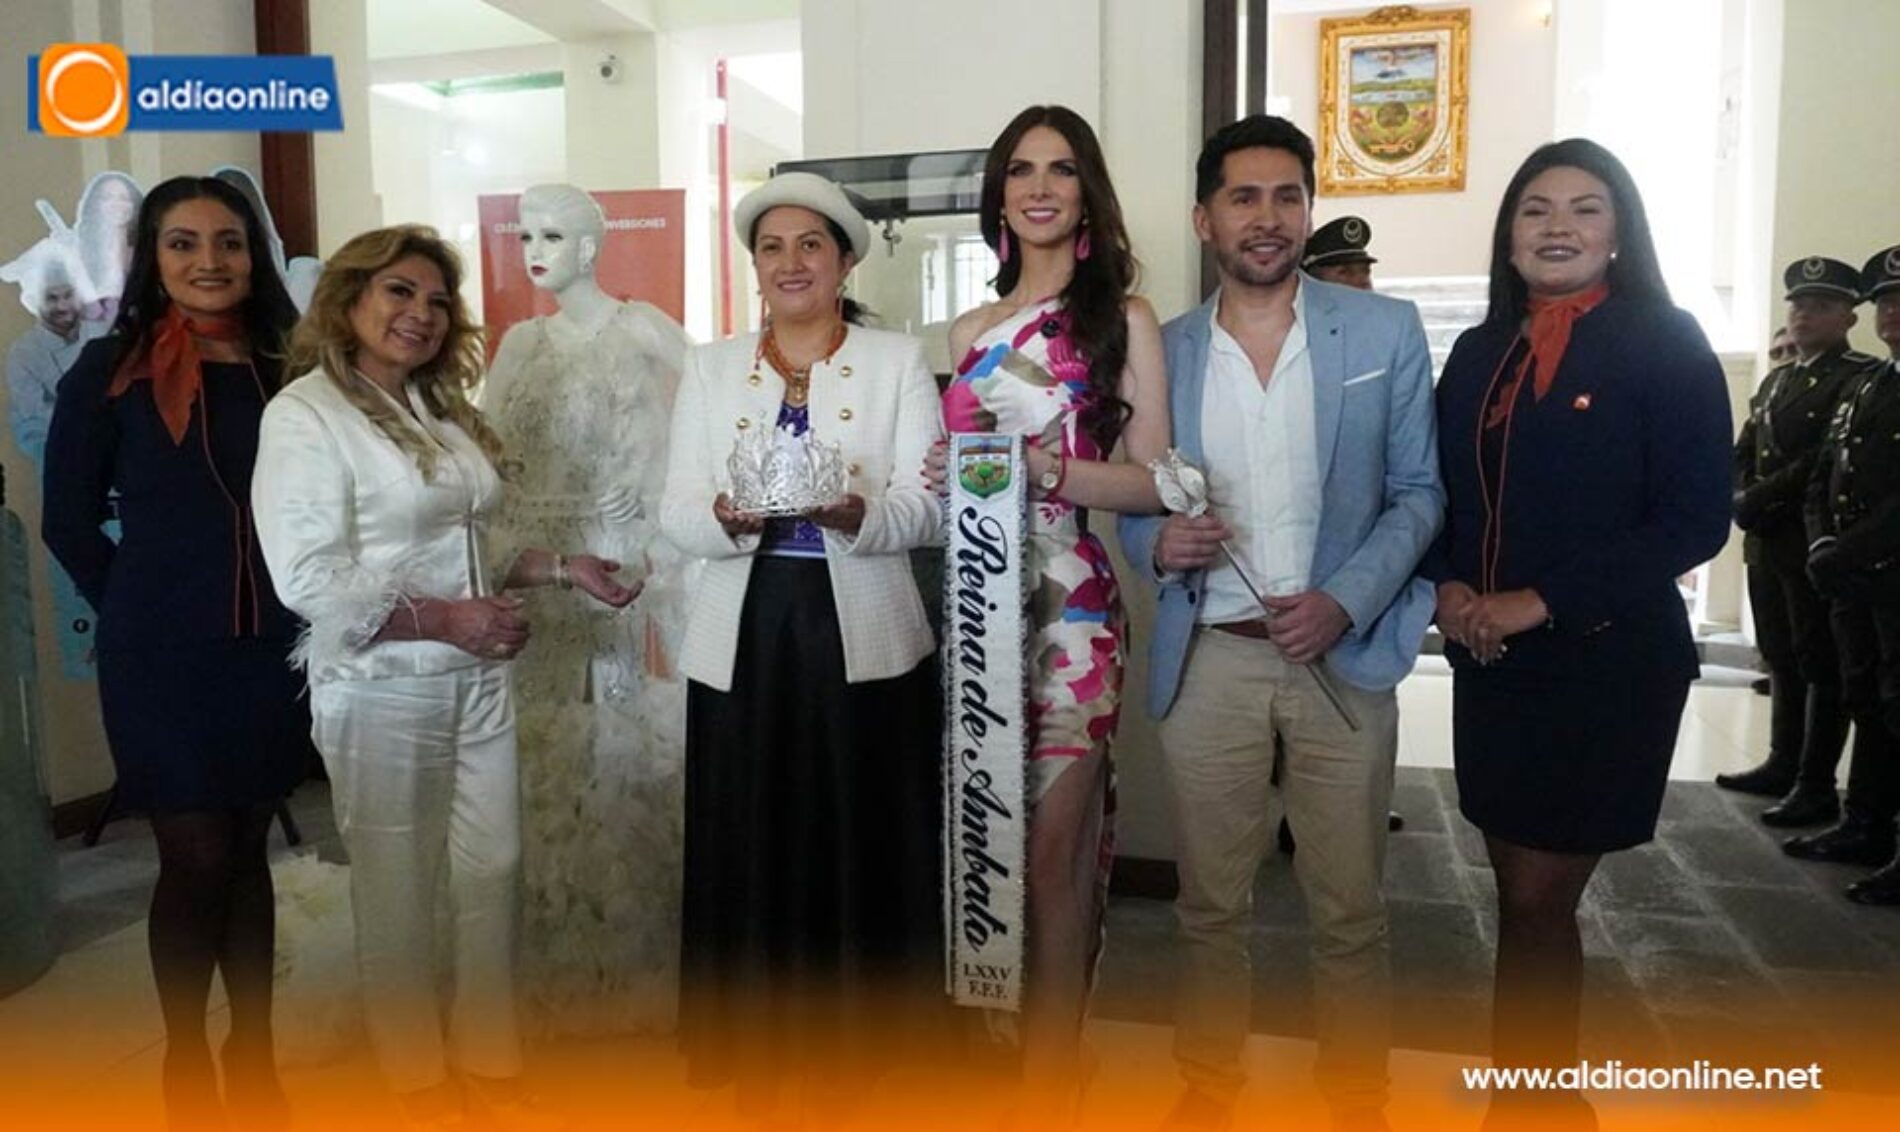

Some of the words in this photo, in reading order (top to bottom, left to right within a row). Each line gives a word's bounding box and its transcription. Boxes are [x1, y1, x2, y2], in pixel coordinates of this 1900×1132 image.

[957, 506, 1008, 676] Reina
[961, 679, 1008, 748] de
[961, 748, 1013, 953] Ambato
[963, 963, 1012, 981] LXXV
